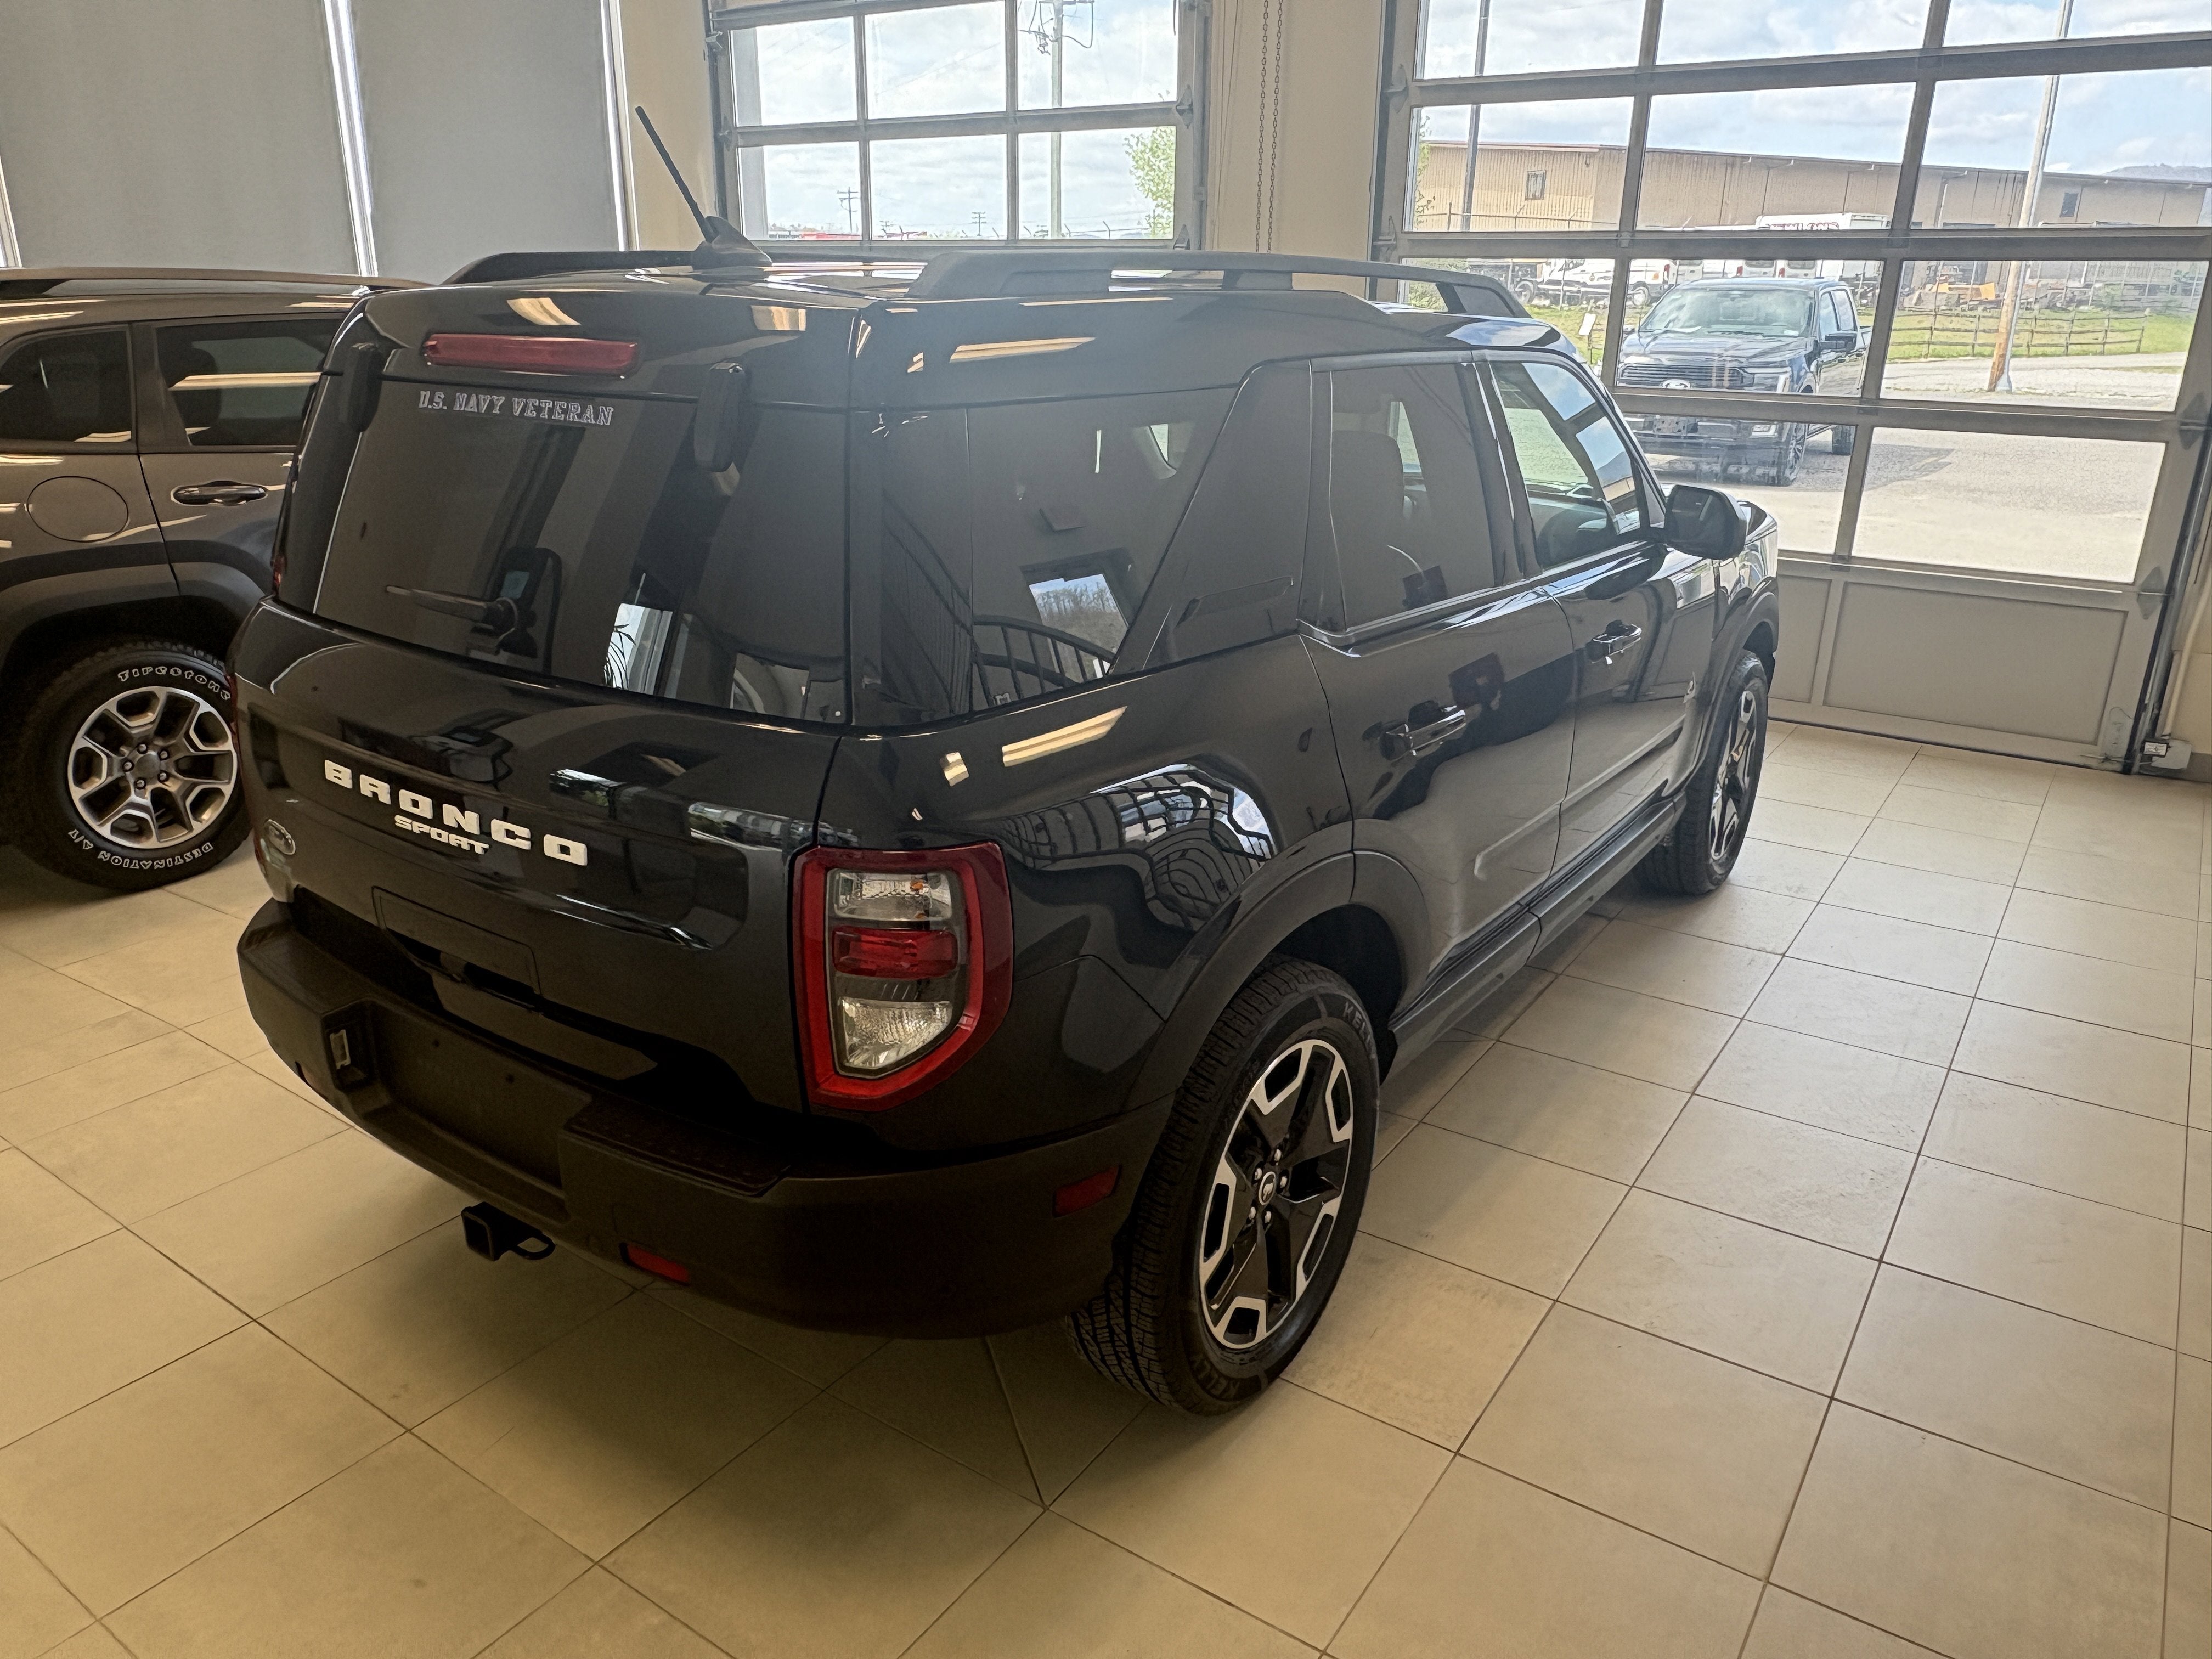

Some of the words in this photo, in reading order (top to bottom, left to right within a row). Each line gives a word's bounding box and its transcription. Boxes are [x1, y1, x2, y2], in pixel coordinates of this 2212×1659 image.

[418, 391, 448, 410] U.S.
[453, 392, 505, 414] NAVY
[512, 397, 614, 426] VETERAN
[325, 760, 588, 866] BRONCO
[67, 829, 94, 850] A/T
[394, 815, 489, 855] SPORT
[97, 842, 213, 870] DESTINATION
